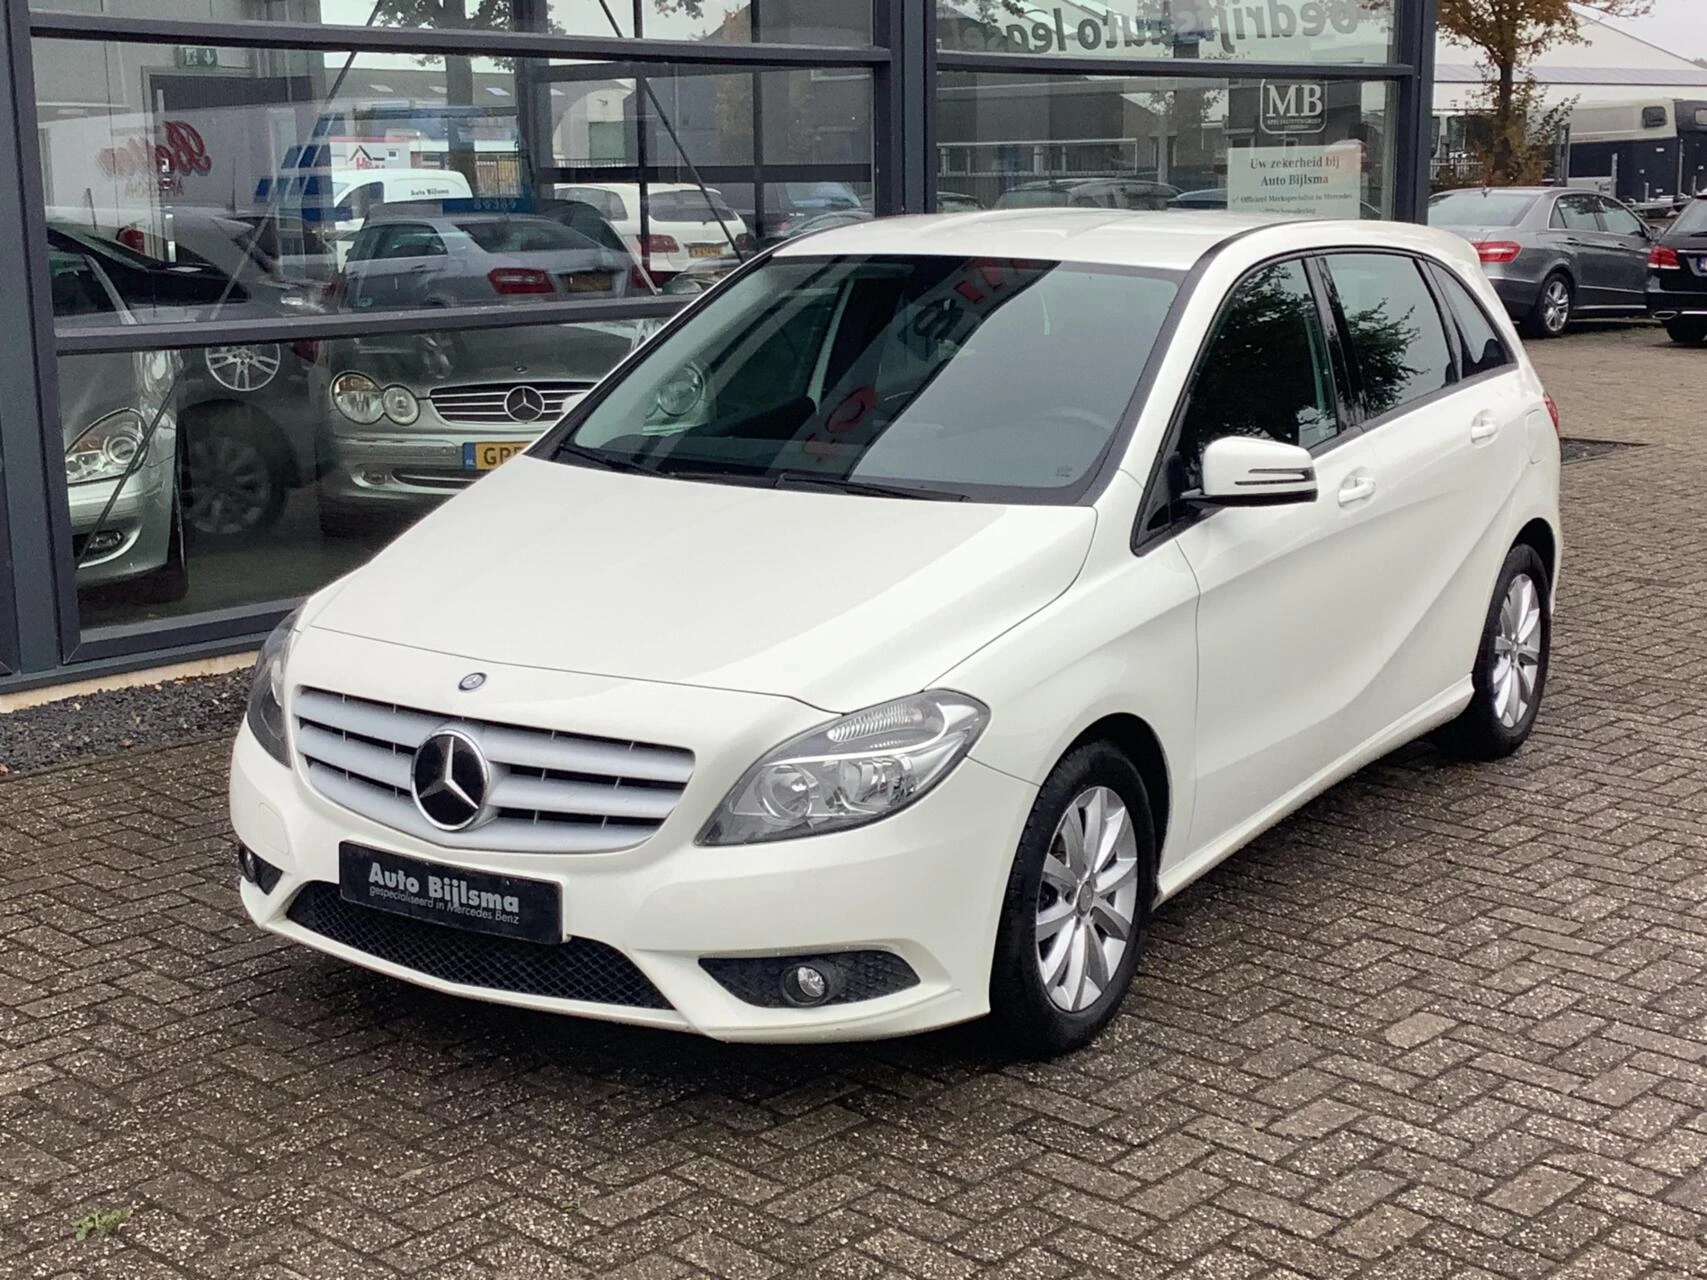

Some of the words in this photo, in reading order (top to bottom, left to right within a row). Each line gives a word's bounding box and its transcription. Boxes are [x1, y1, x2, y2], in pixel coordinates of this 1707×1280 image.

[1266, 84, 1324, 117] MB
[1250, 157, 1267, 169] Uw
[1270, 156, 1323, 168] zekerheid
[1326, 155, 1340, 169] bij
[1261, 175, 1286, 186] Auto
[1289, 173, 1329, 187] Bijlsma
[368, 861, 420, 894] Auto
[427, 875, 520, 913] Bijlsma
[368, 885, 434, 908] gespecialiseerd
[435, 901, 445, 911] in
[446, 902, 493, 921] Mercedes
[495, 910, 520, 925] Benz
